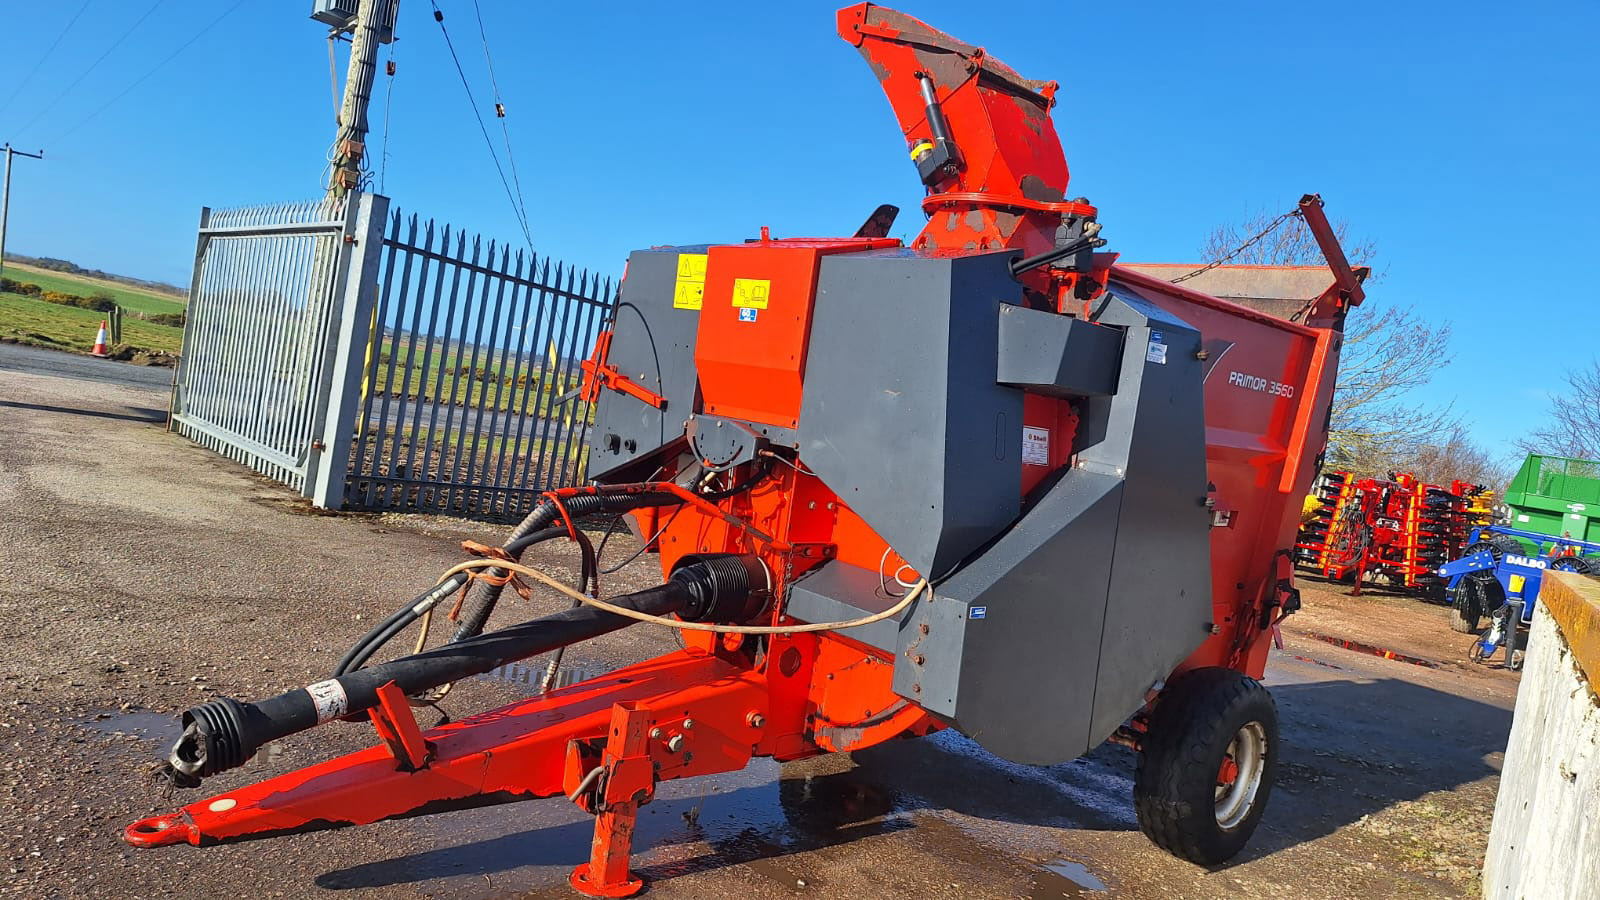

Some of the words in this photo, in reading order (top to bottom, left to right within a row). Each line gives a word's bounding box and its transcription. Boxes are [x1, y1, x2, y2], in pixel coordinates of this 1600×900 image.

[1229, 371, 1267, 392] PRIMOR
[1268, 381, 1294, 398] 3560
[1506, 555, 1546, 570] DALBO
